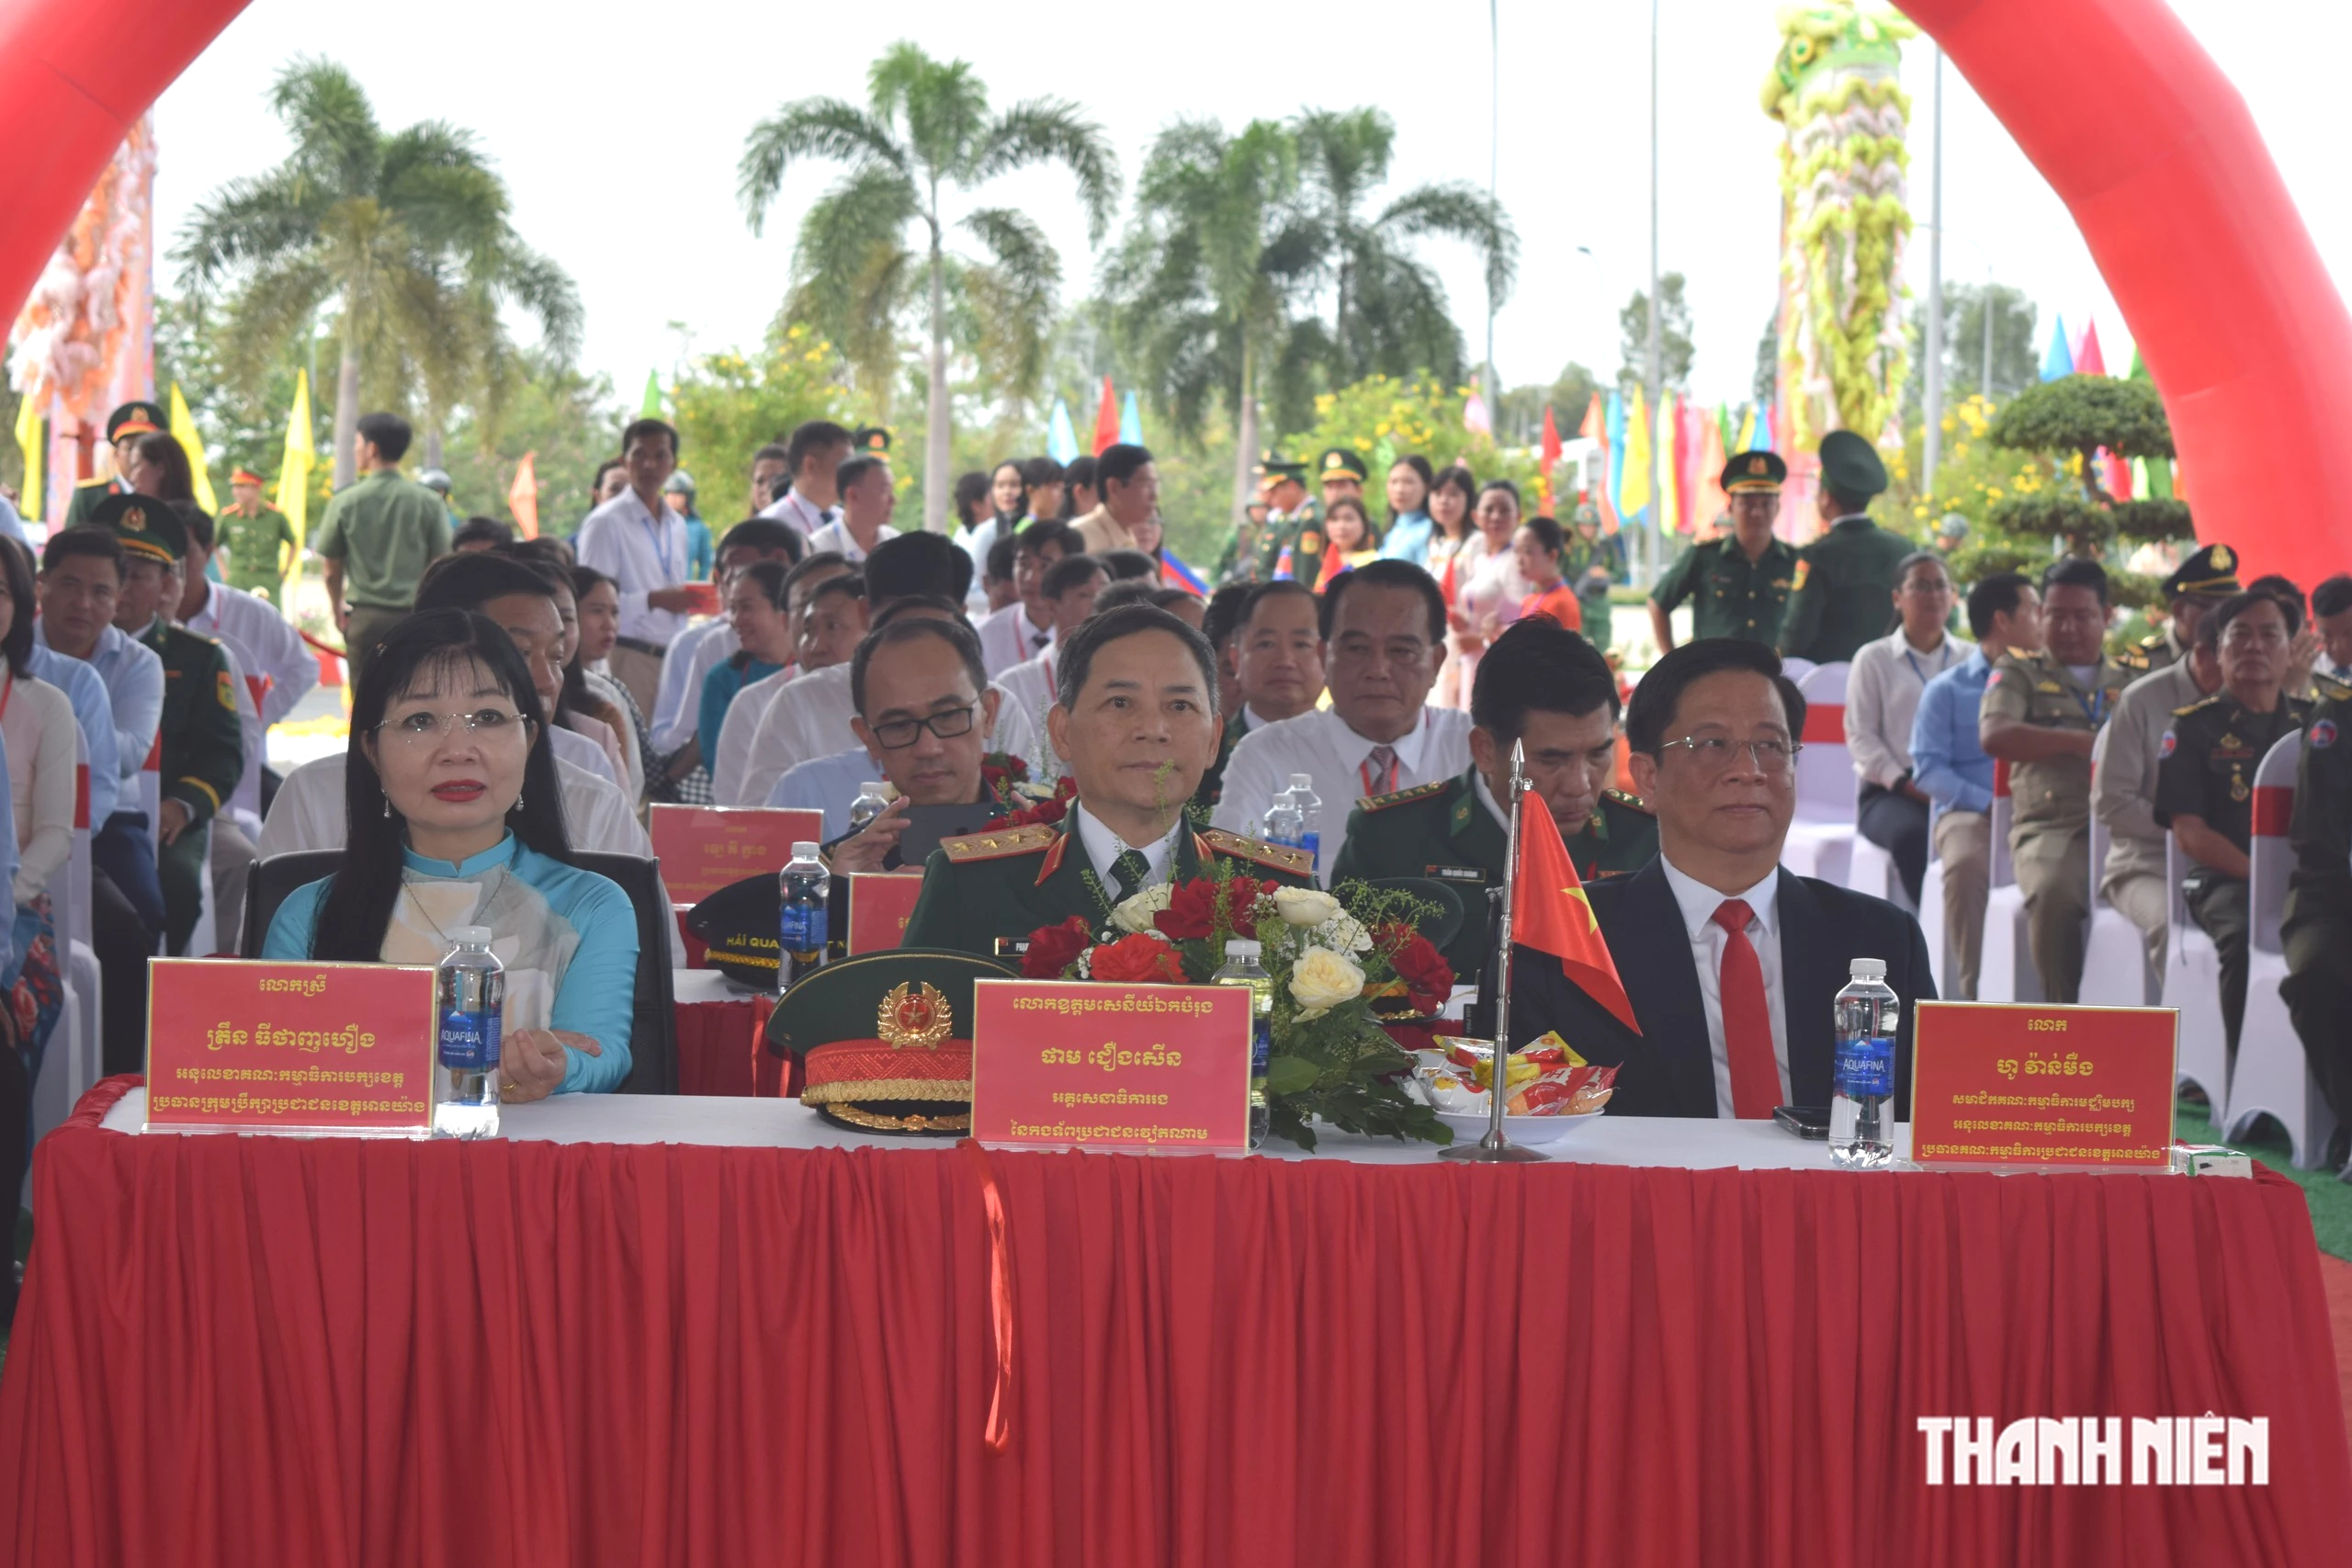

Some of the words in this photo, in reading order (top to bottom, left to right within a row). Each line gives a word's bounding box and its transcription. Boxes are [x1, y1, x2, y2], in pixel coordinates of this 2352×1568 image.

[751, 939, 778, 949] QUA
[260, 975, 325, 997] លោកស្រី
[2029, 1019, 2067, 1031] លោក
[441, 1029, 482, 1044] AQUAFINA
[1843, 1058, 1886, 1072] AQUAFINA
[1997, 1059, 2018, 1079] ហូ
